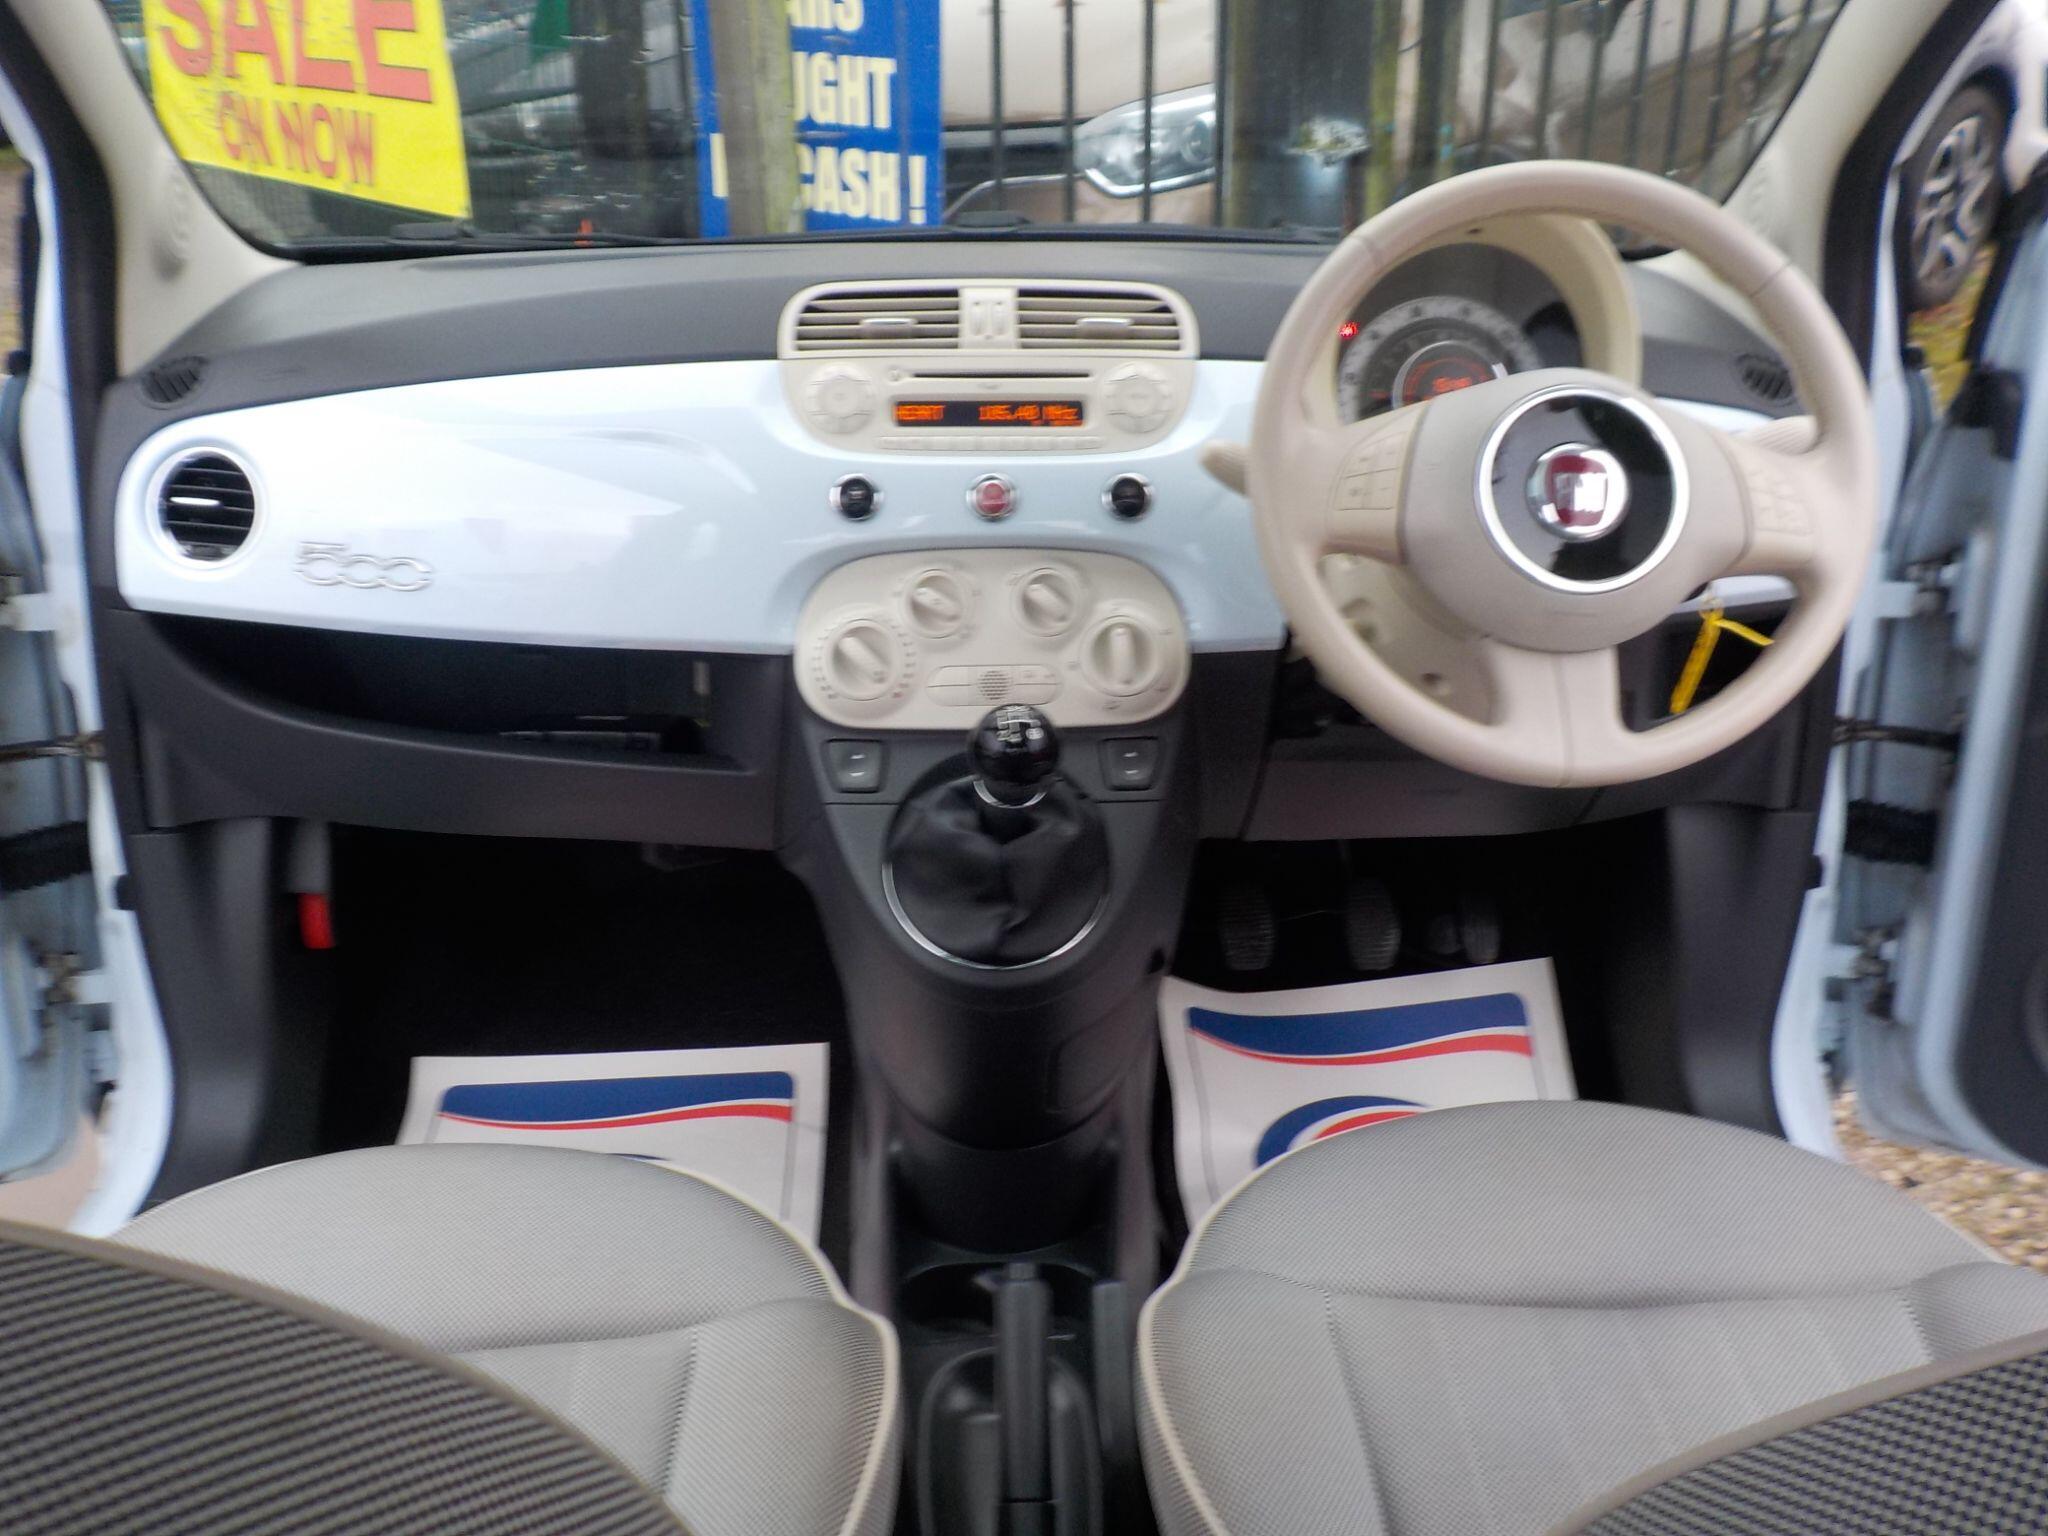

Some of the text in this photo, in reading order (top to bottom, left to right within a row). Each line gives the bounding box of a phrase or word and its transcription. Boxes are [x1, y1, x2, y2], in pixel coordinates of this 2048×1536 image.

[161, 0, 432, 103] SALE
[218, 91, 375, 186] ON NOW
[294, 540, 432, 592] 500
